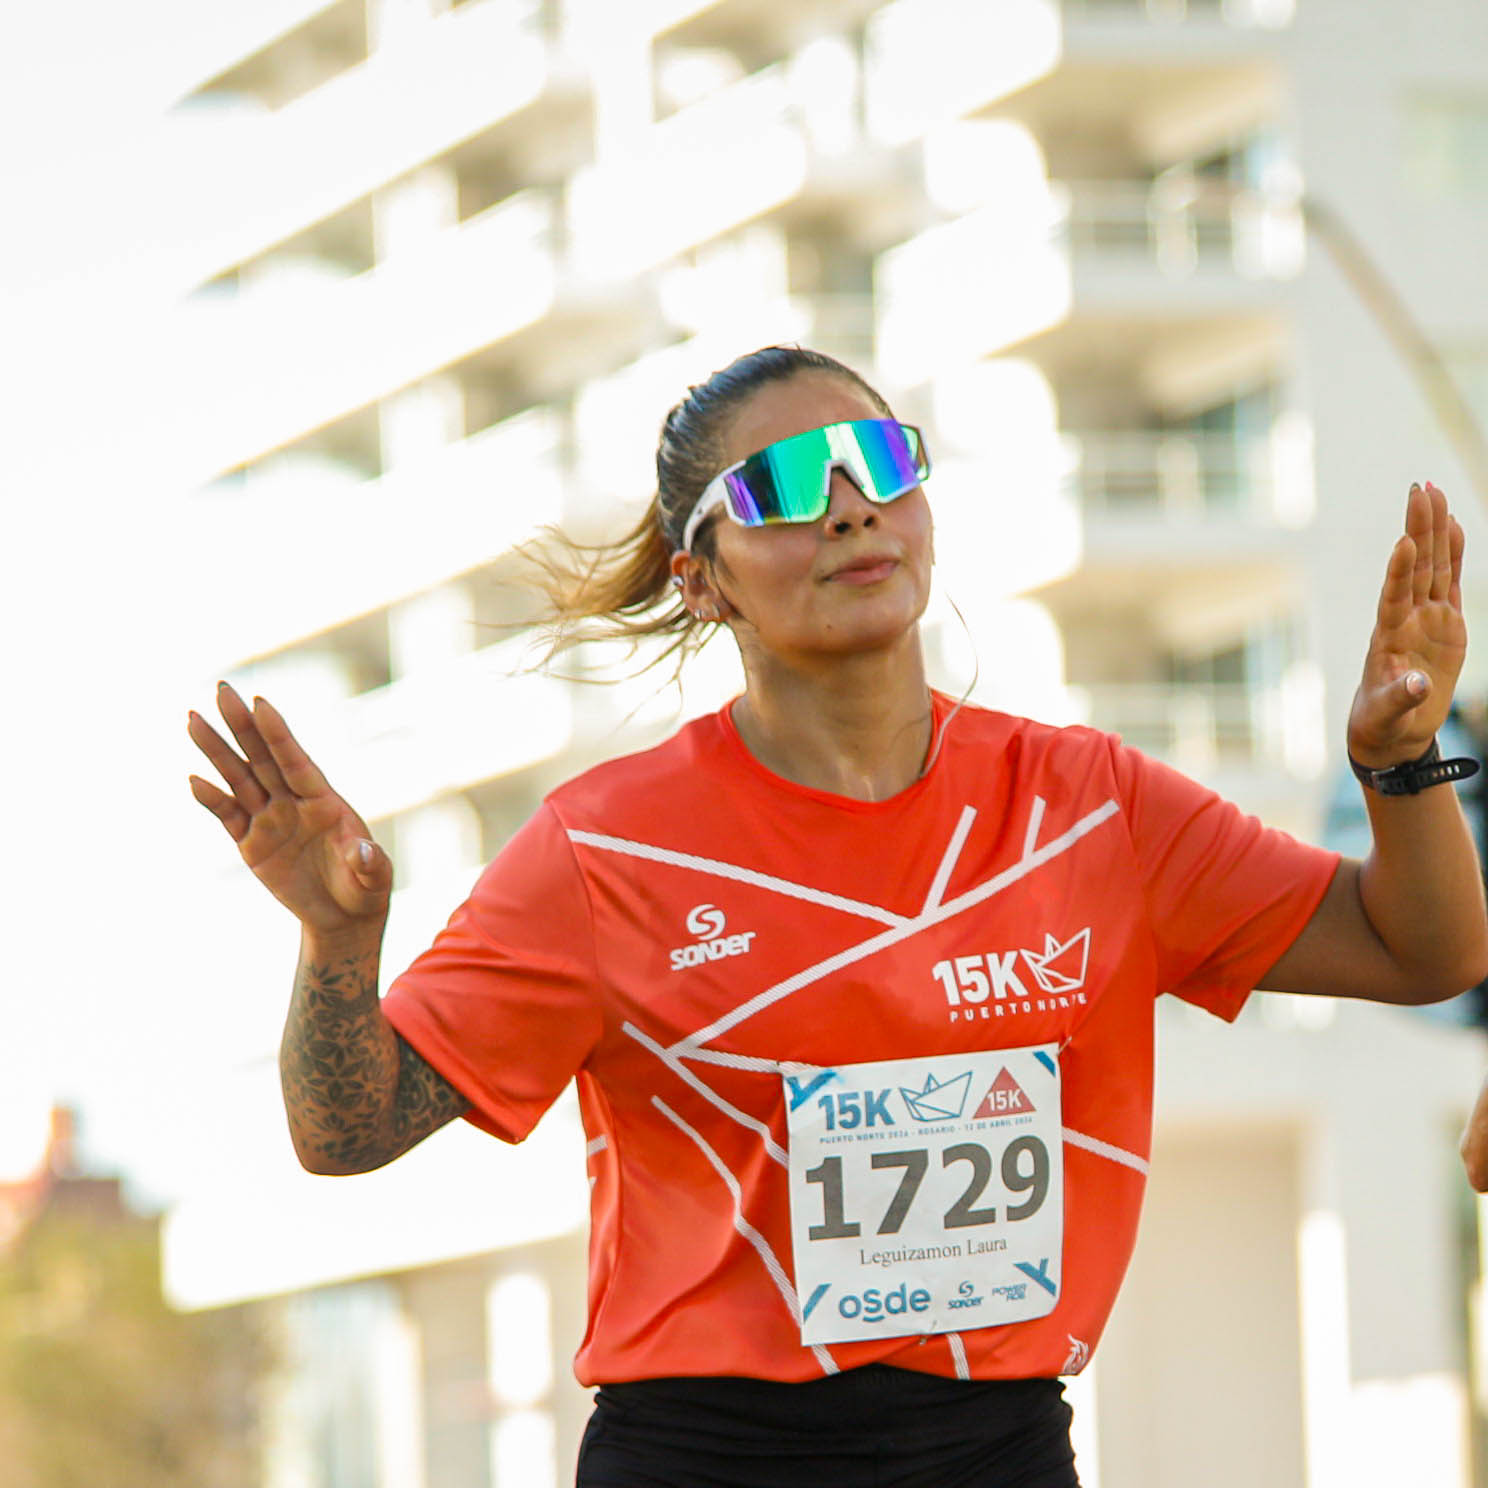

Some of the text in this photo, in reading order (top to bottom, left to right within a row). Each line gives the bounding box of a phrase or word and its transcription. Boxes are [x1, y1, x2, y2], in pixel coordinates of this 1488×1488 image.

[931, 950, 1029, 1006] 15K
[949, 1001, 1032, 1022] PUERTO
[817, 1088, 896, 1131] 15K
[986, 1088, 1024, 1111] 15K
[819, 1135, 854, 1143] PUERTO
[856, 1132, 885, 1141] NORTE
[918, 1125, 955, 1136] ROSARIO
[990, 1119, 1011, 1128] ABRIL
[805, 1135, 1050, 1241] 1729
[860, 1238, 1008, 1268] Leguizamon Laura
[838, 1281, 932, 1320] osde
